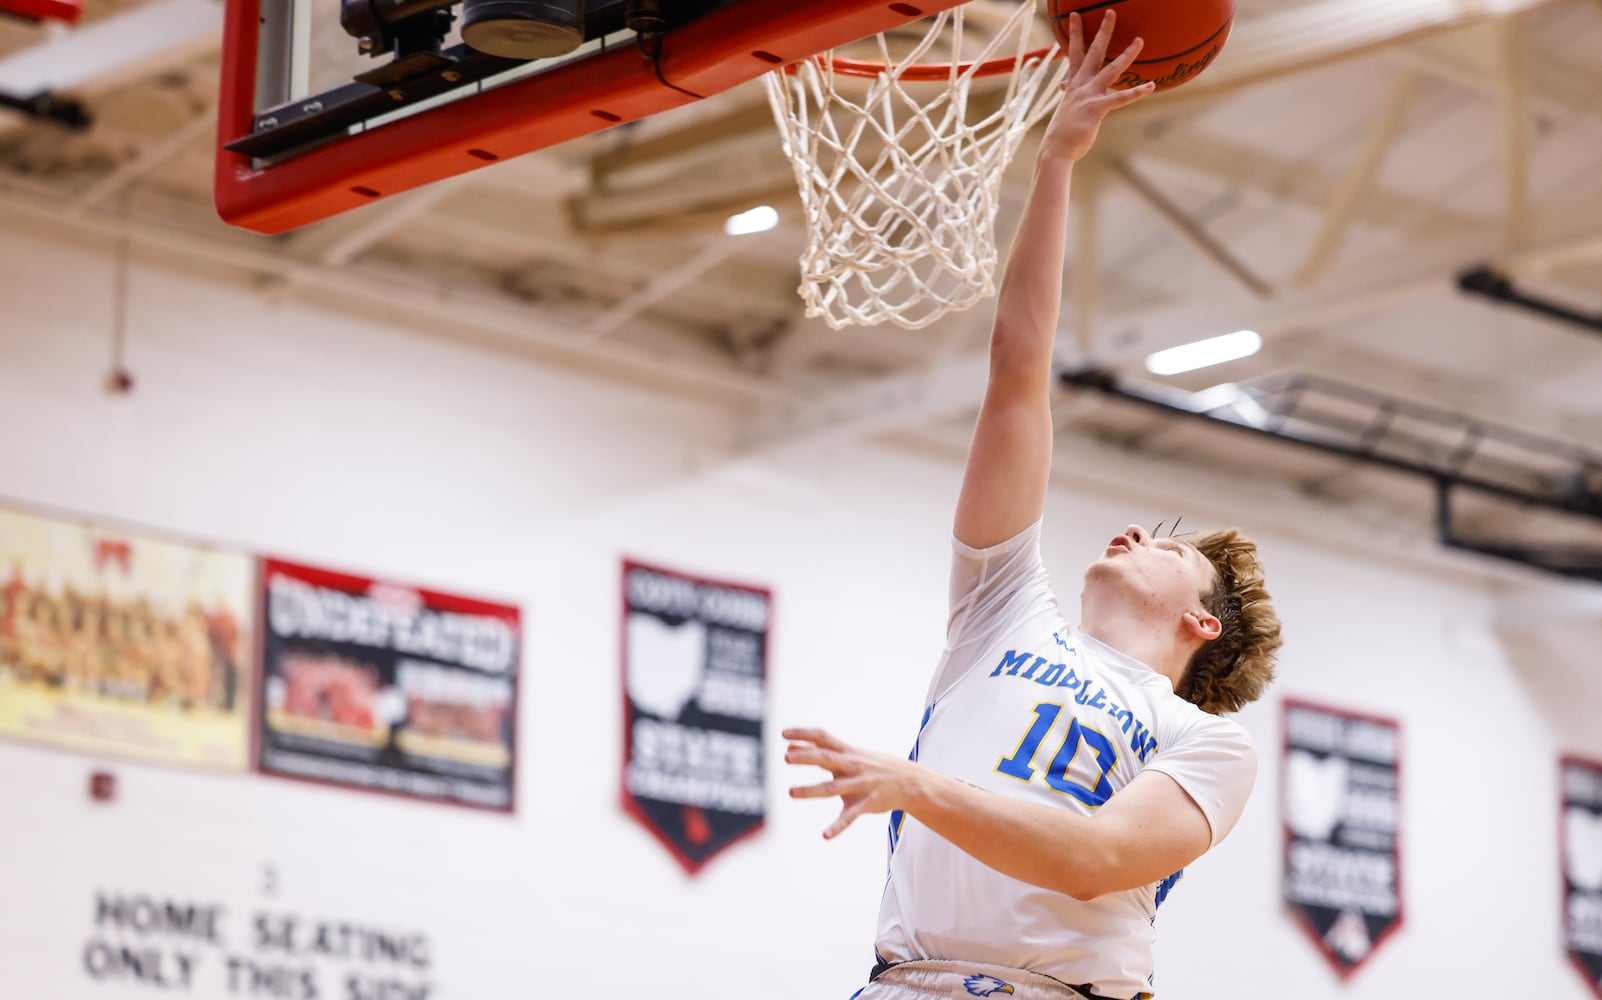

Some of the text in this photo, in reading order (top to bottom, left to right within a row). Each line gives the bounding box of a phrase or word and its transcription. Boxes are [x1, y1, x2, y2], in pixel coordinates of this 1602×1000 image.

[269, 573, 512, 671] UNDEFEATED
[989, 650, 1158, 764] MIDDLEOW
[994, 701, 1120, 809] 10
[83, 940, 196, 987] ONLY
[226, 956, 318, 999] THIS
[95, 891, 430, 967] HOME SEATING
